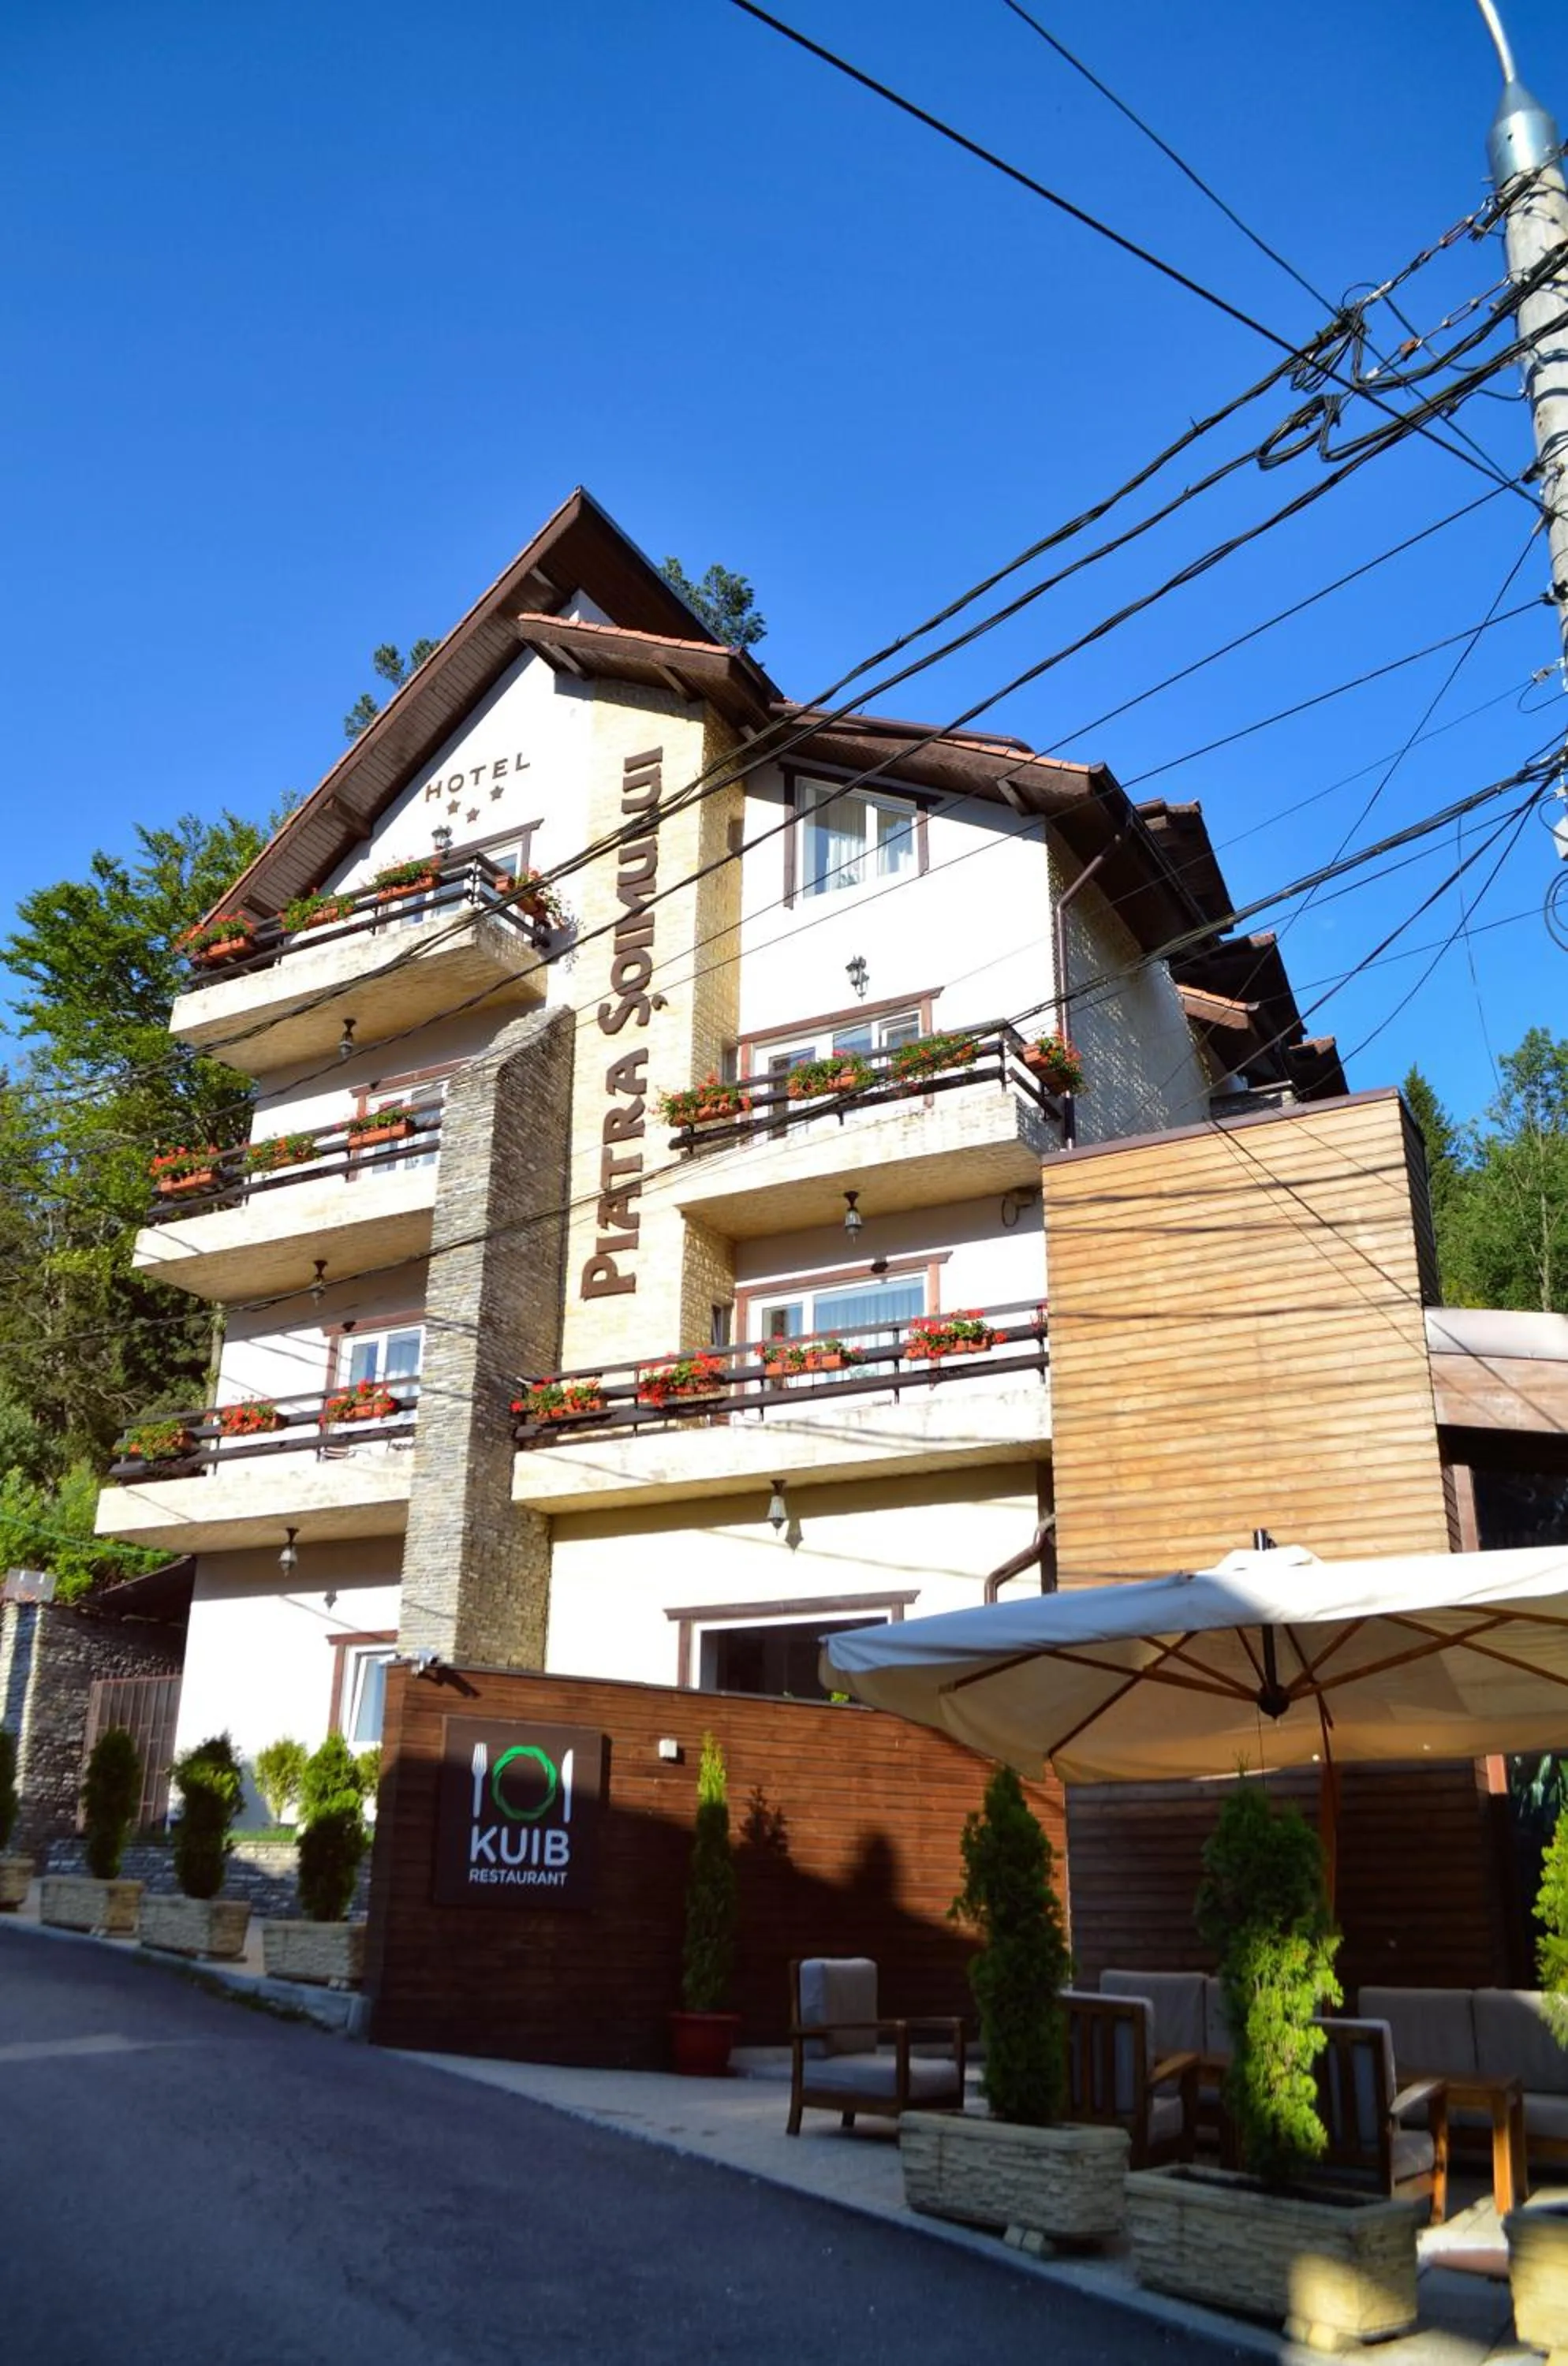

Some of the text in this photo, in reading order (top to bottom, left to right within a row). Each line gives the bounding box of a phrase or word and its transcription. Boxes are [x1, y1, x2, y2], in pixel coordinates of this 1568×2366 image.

[424, 752, 531, 802] HOTEL
[580, 1047, 649, 1301] PIATRA
[469, 1825, 570, 1867] KUIB
[469, 1868, 568, 1886] RESTAURANT
